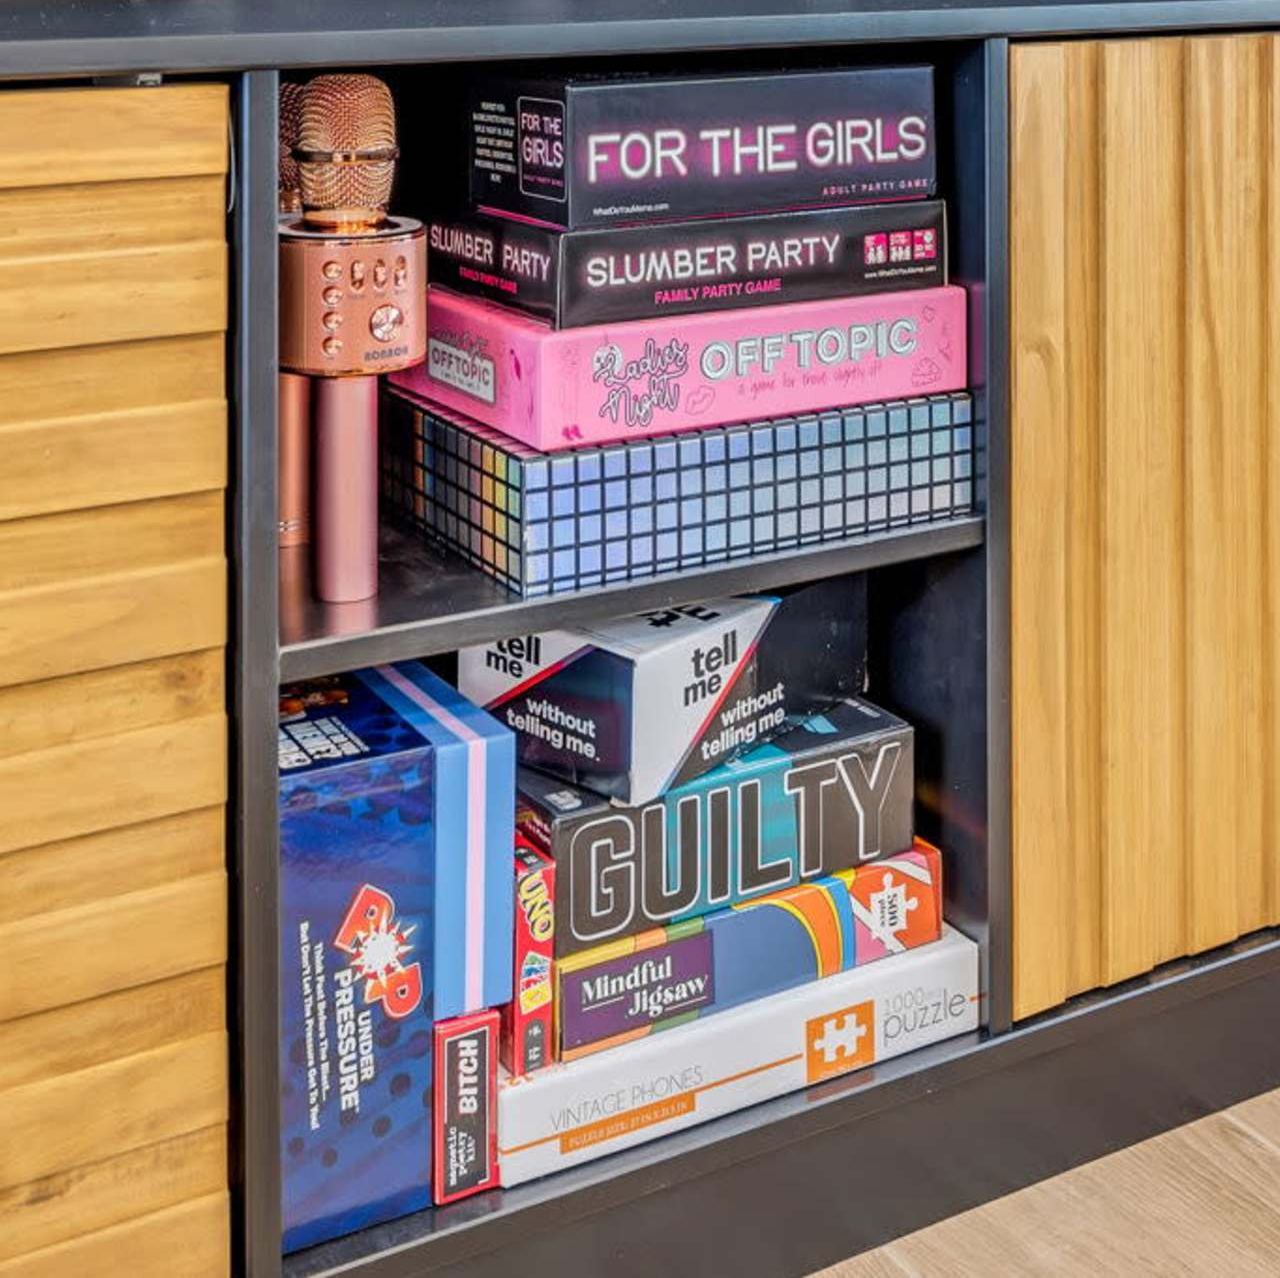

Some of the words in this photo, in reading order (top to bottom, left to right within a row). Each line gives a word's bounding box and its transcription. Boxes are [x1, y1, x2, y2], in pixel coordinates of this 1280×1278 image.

[520, 112, 541, 132] FOR
[542, 116, 562, 136] THE
[522, 135, 565, 169] GIRLS
[587, 128, 688, 184] FOR
[699, 124, 798, 177] THE
[806, 115, 927, 167] GIRLS
[821, 183, 857, 197] ADULT
[860, 180, 895, 193] PARTY
[429, 223, 494, 265] SLUMBER
[502, 243, 552, 282] PARTY
[586, 240, 737, 288] SLUMBER
[747, 233, 841, 273] PARTY
[654, 288, 698, 305] FAMILY
[701, 283, 745, 299] PARTY
[746, 277, 782, 295] GAME
[594, 337, 689, 386] Ladies
[599, 370, 681, 427] Night
[486, 650, 524, 679] me
[691, 629, 738, 679] tell
[683, 673, 722, 707] me
[721, 682, 785, 727] without
[505, 707, 564, 750] telling
[526, 697, 597, 739] without
[701, 720, 757, 761] telling
[570, 741, 902, 942] GUILTY
[518, 868, 555, 942] UNO
[887, 893, 898, 927] 500
[581, 954, 673, 1005] Mindful
[624, 973, 709, 1019] Jigsaw
[333, 968, 360, 1112] PRESSURE
[884, 988, 966, 1047] puzzle
[358, 1009, 375, 1083] UNDER
[458, 1039, 479, 1114] BITCH
[550, 1090, 627, 1131] VINTAGE
[631, 1065, 705, 1106] PHONES
[448, 1126, 458, 1187] magnetic
[458, 1131, 468, 1176] poetry
